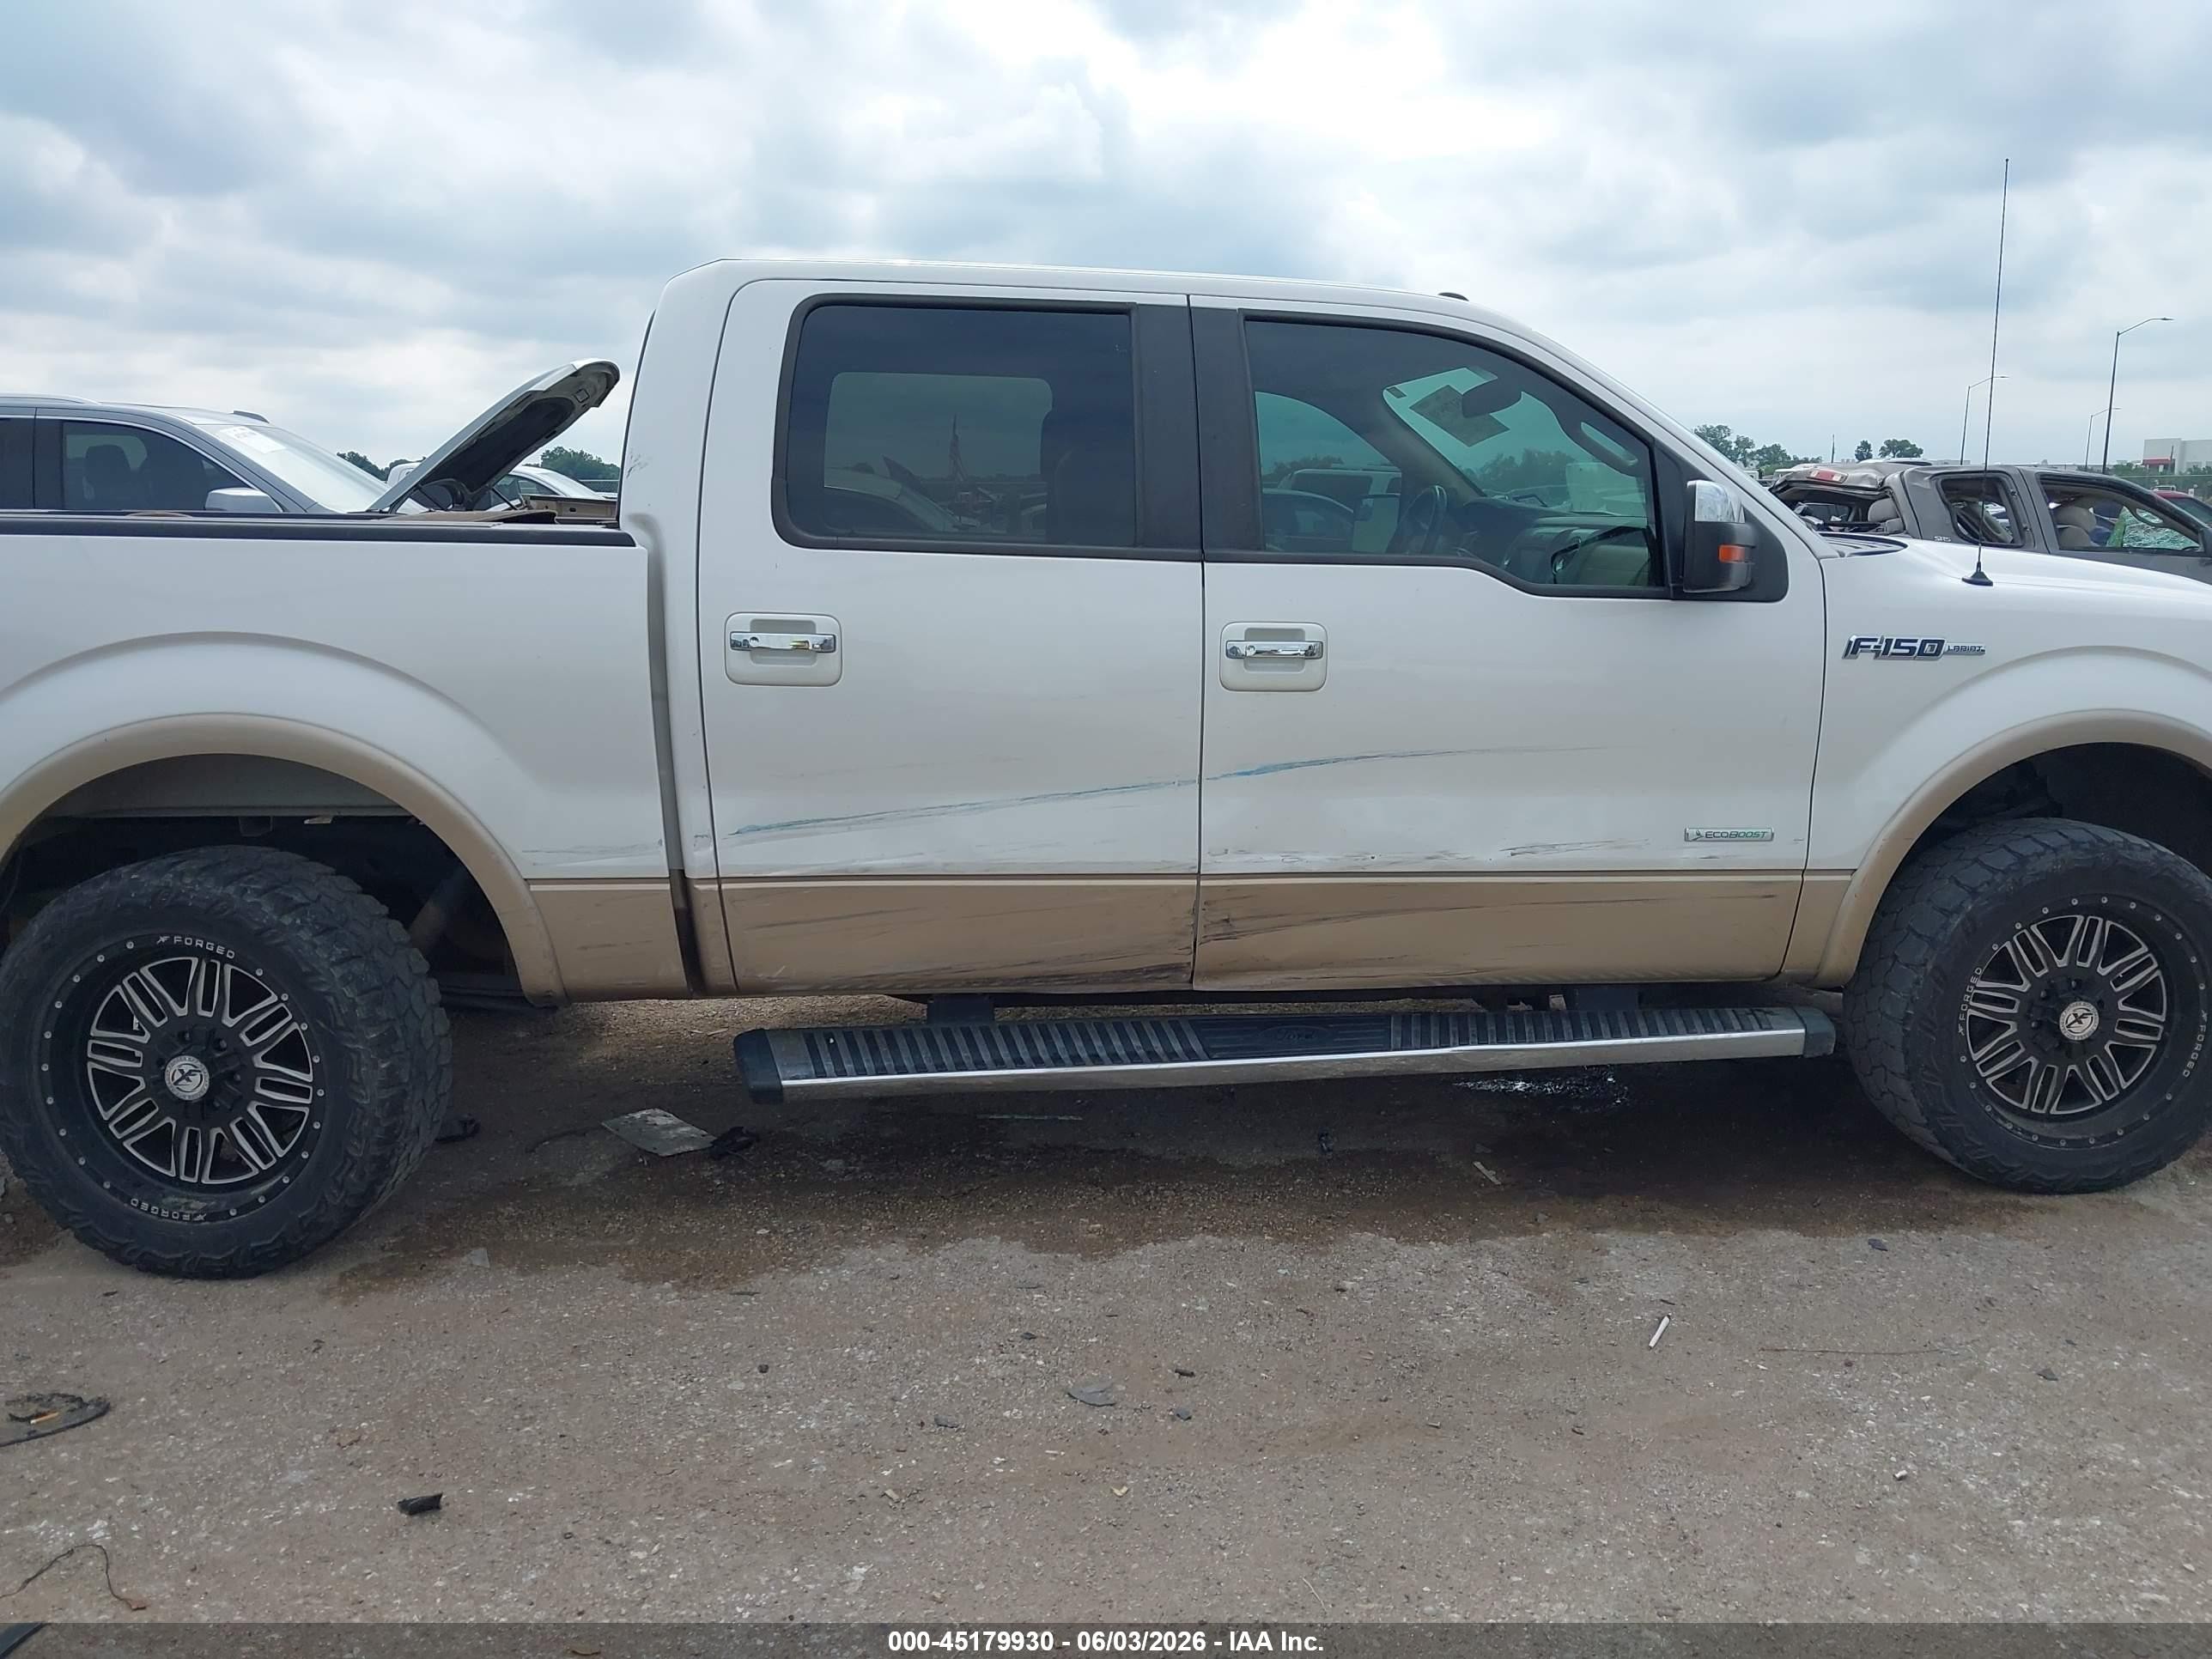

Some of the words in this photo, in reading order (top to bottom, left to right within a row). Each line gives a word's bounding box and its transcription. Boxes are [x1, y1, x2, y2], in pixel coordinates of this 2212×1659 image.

[1843, 635, 1947, 660] F-150
[173, 935, 235, 959] FORGED
[1959, 967, 1983, 1021] FORGED
[2183, 1024, 2207, 1078] FORGED
[131, 1198, 191, 1221] FORGED
